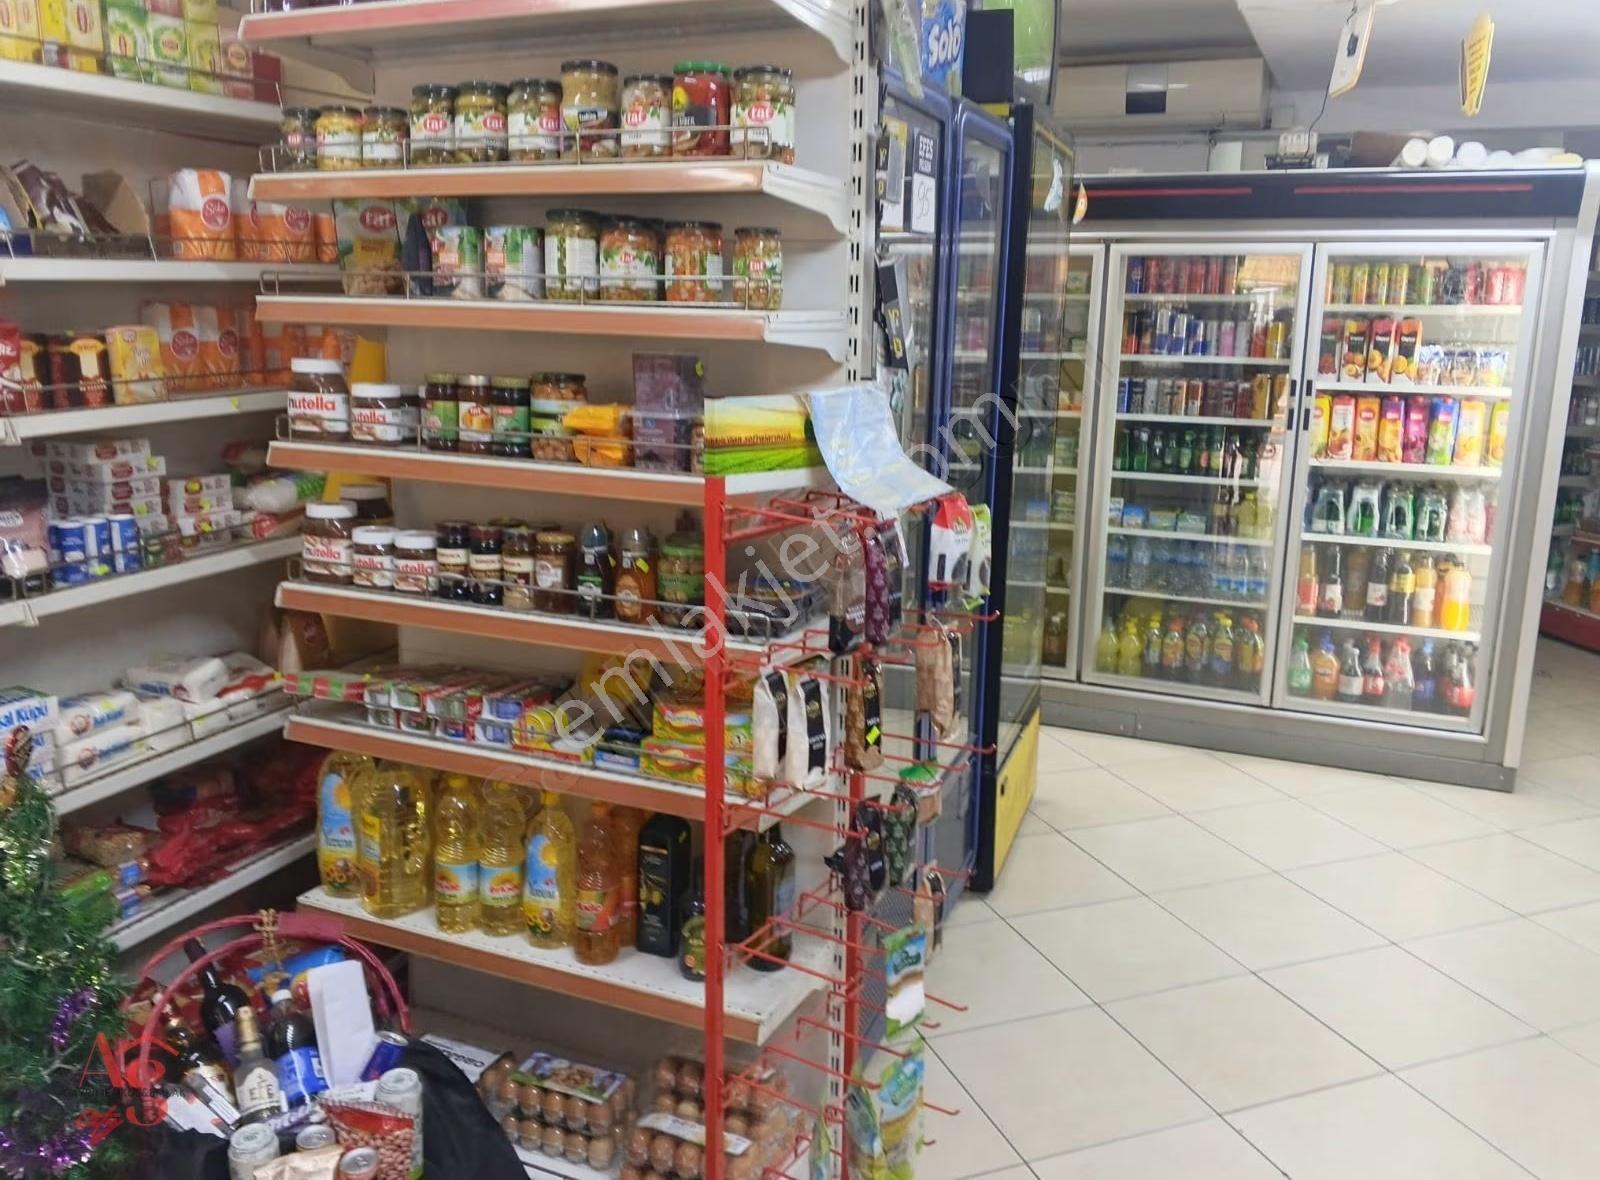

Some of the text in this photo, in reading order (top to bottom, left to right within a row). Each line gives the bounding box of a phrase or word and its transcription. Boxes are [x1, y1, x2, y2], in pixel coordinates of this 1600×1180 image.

[928, 18, 962, 68] Solo
[288, 393, 337, 412] nutella
[305, 547, 342, 562] nutella
